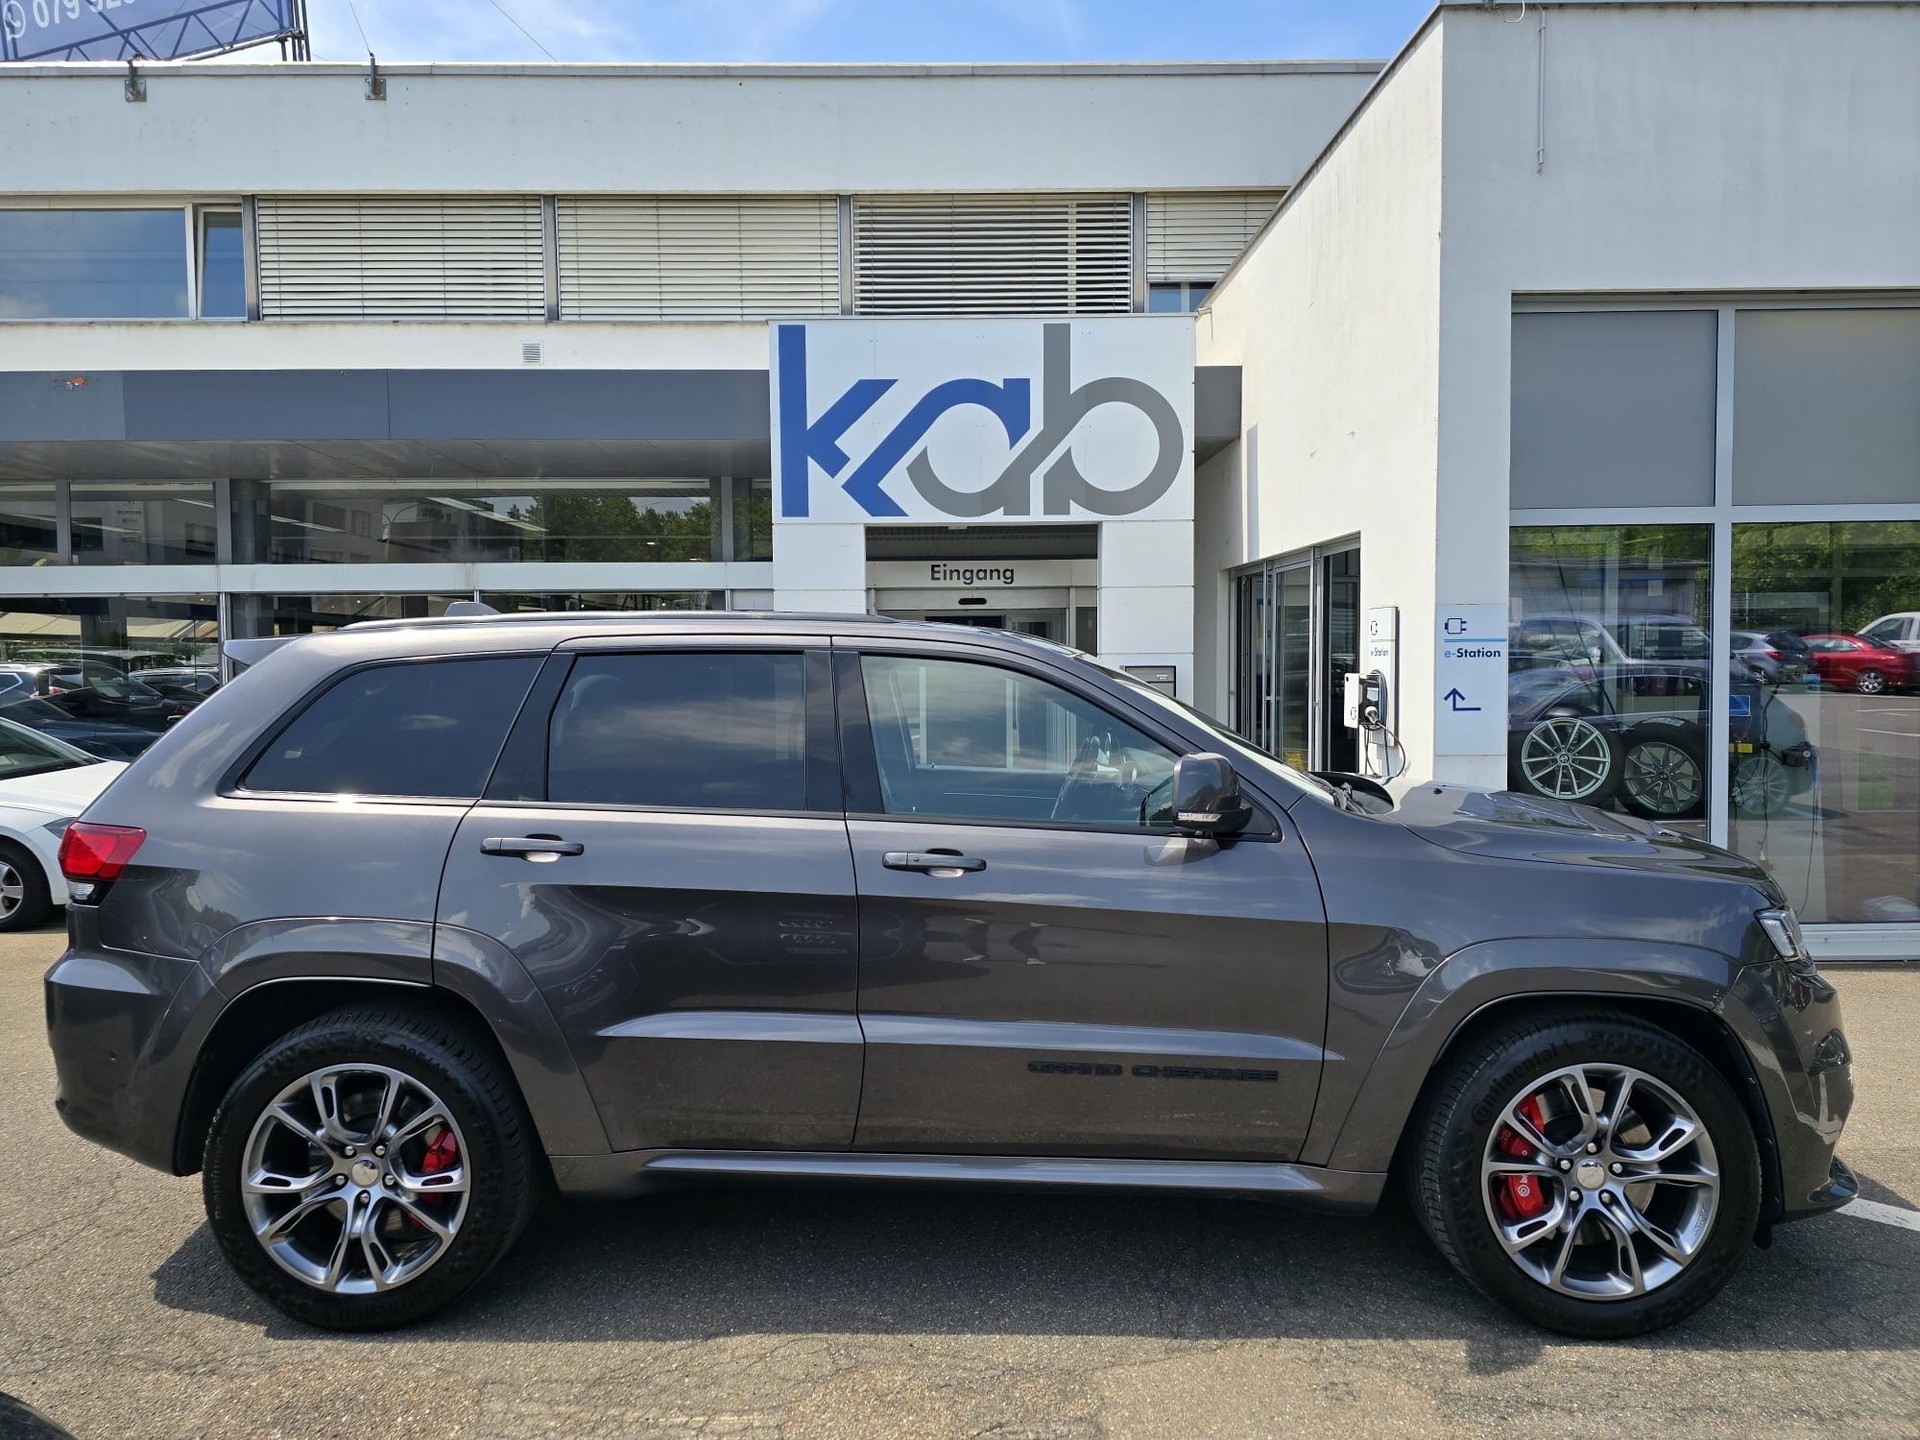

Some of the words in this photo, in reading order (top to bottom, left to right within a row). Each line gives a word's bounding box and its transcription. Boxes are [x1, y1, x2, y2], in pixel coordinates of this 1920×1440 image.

[778, 323, 1184, 518] kab
[930, 563, 1015, 585] Eingang
[1444, 647, 1501, 659] e-Station
[1027, 1060, 1123, 1076] GRAND
[1131, 1064, 1279, 1082] CHEROKEE
